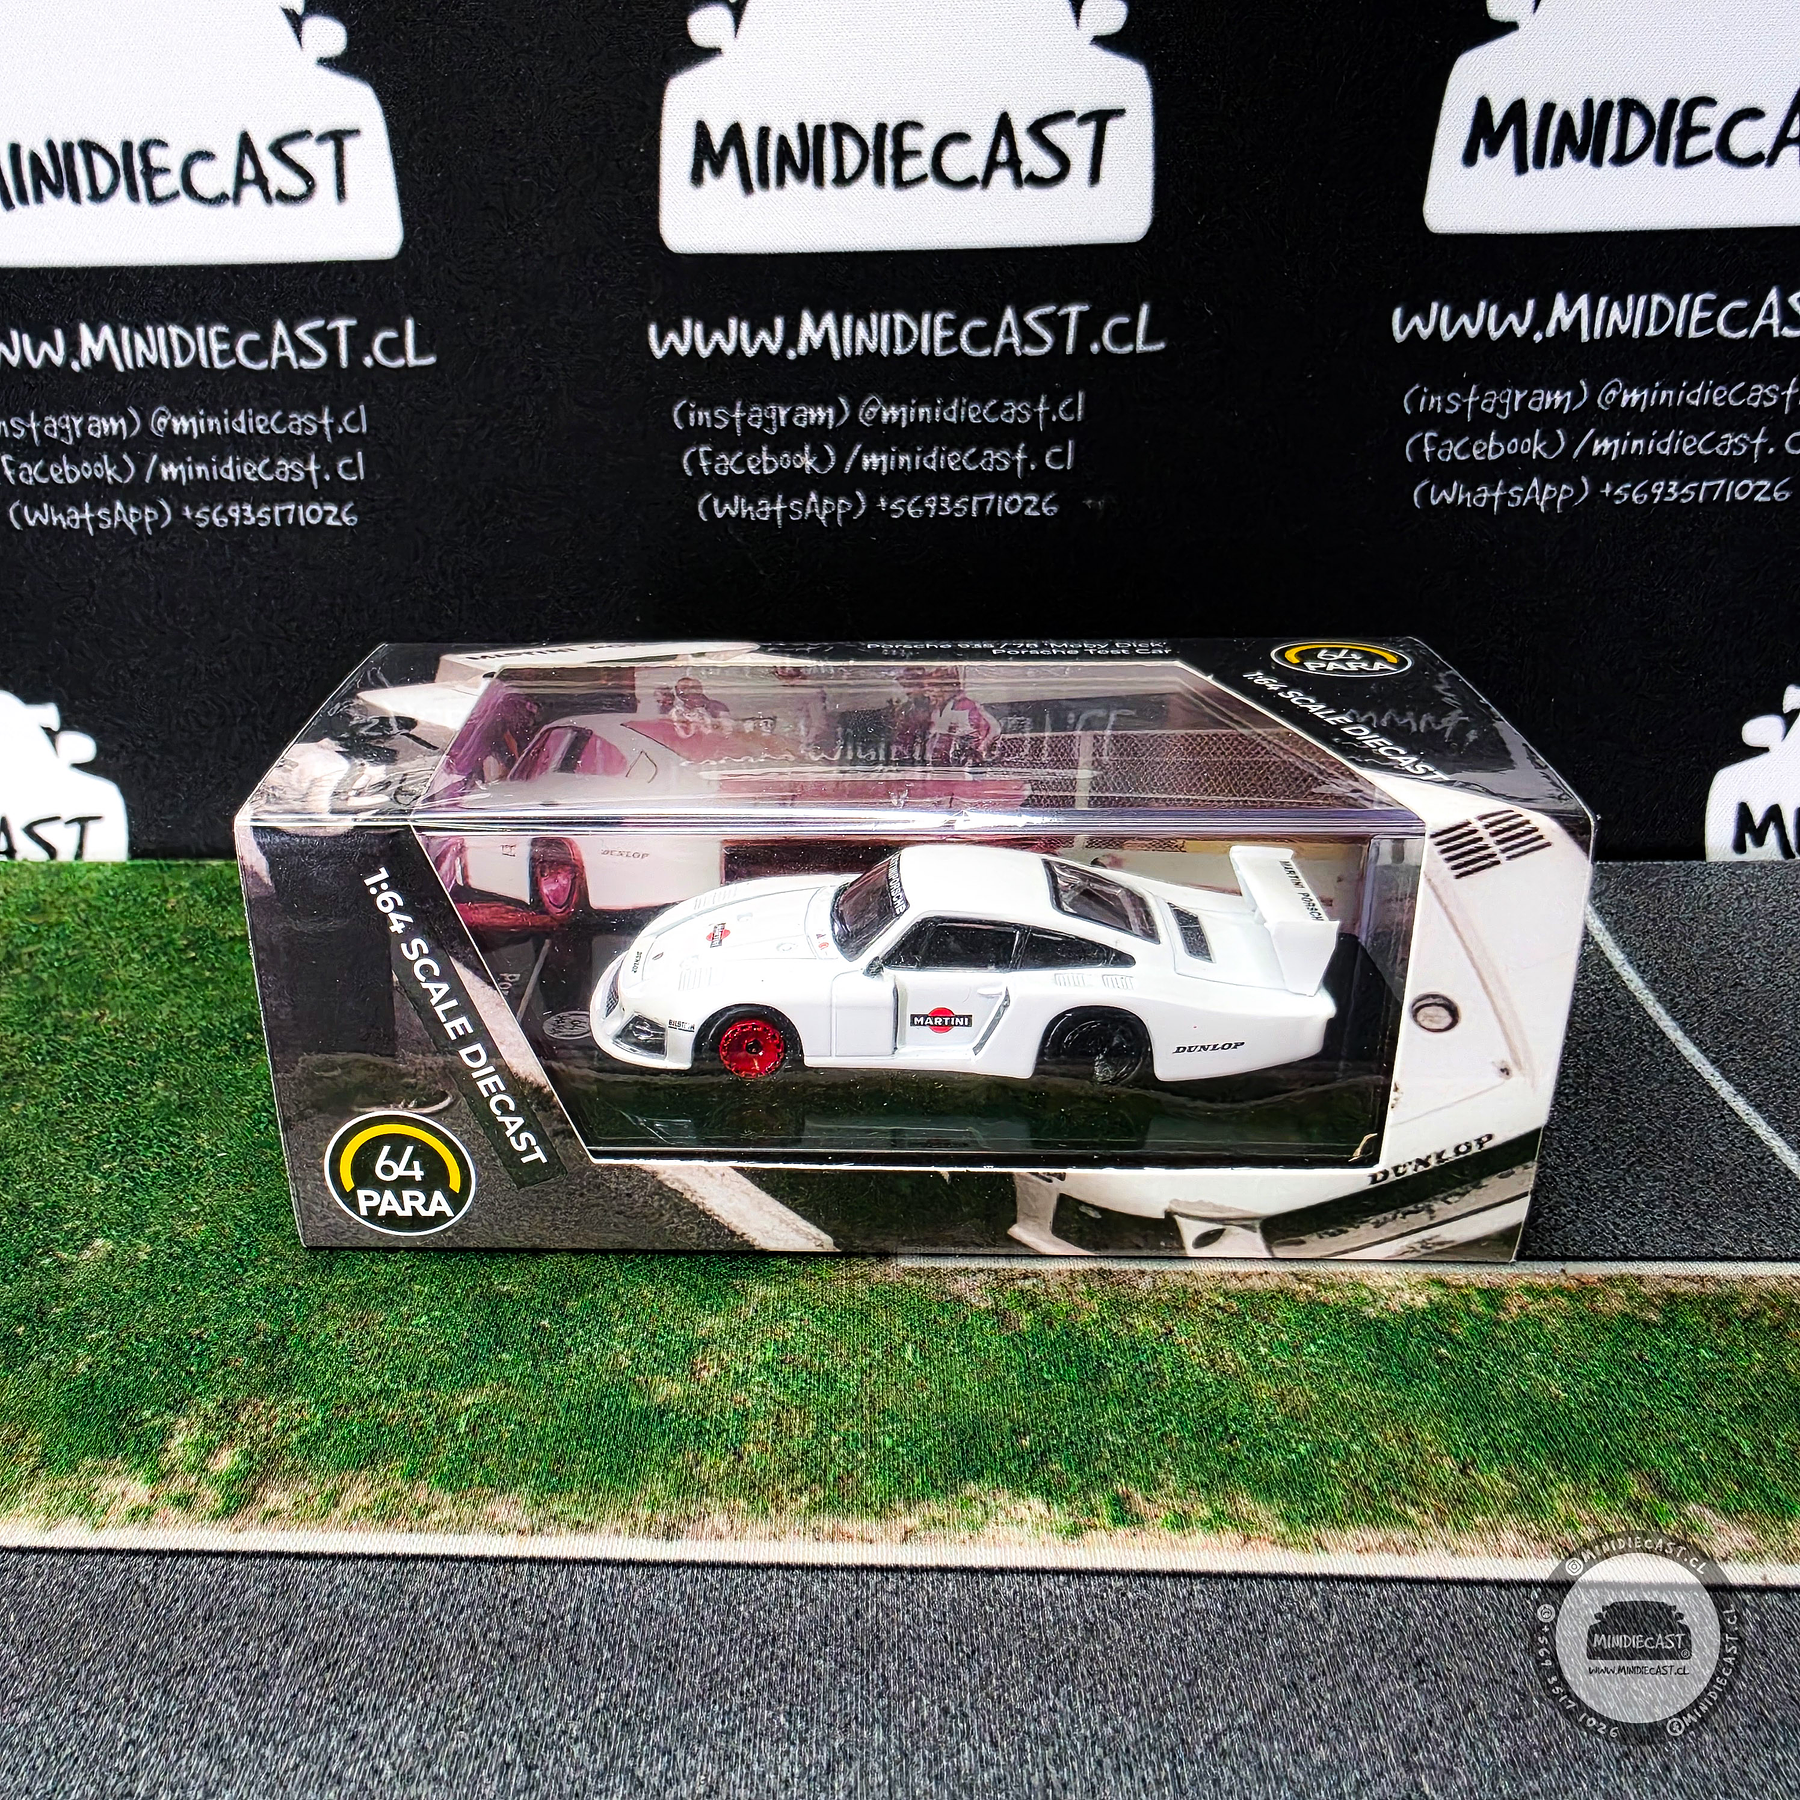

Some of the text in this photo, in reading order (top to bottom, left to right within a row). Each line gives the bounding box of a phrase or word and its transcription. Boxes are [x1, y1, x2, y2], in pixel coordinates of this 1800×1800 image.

[0, 128, 361, 212] INIDIECAST
[690, 108, 1127, 196] MINIDIECAST
[673, 391, 1085, 435] (instagram) @minidiecast.cl
[1403, 379, 1589, 422] (instagram)
[150, 404, 367, 443] @minidiecast.cl
[697, 490, 1058, 527] (WhatsApp) +56935171026
[1413, 475, 1792, 514] (WhatsApp) +56935171026
[8, 498, 358, 537] (WhatsApp) +56935171026
[1302, 661, 1398, 672] PARA
[1316, 648, 1362, 661] 64
[1242, 669, 1288, 692] 1:64
[1278, 689, 1354, 726] SCALE
[1340, 724, 1452, 782] DIECAST
[364, 867, 548, 1165] 1:64 SCALE DIECAST
[913, 1016, 970, 1026] MARTINI
[1172, 1041, 1246, 1055] DUNLOP
[375, 1144, 424, 1182] 64
[1368, 1133, 1495, 1186] DUNLOP
[356, 1188, 455, 1218] PARA
